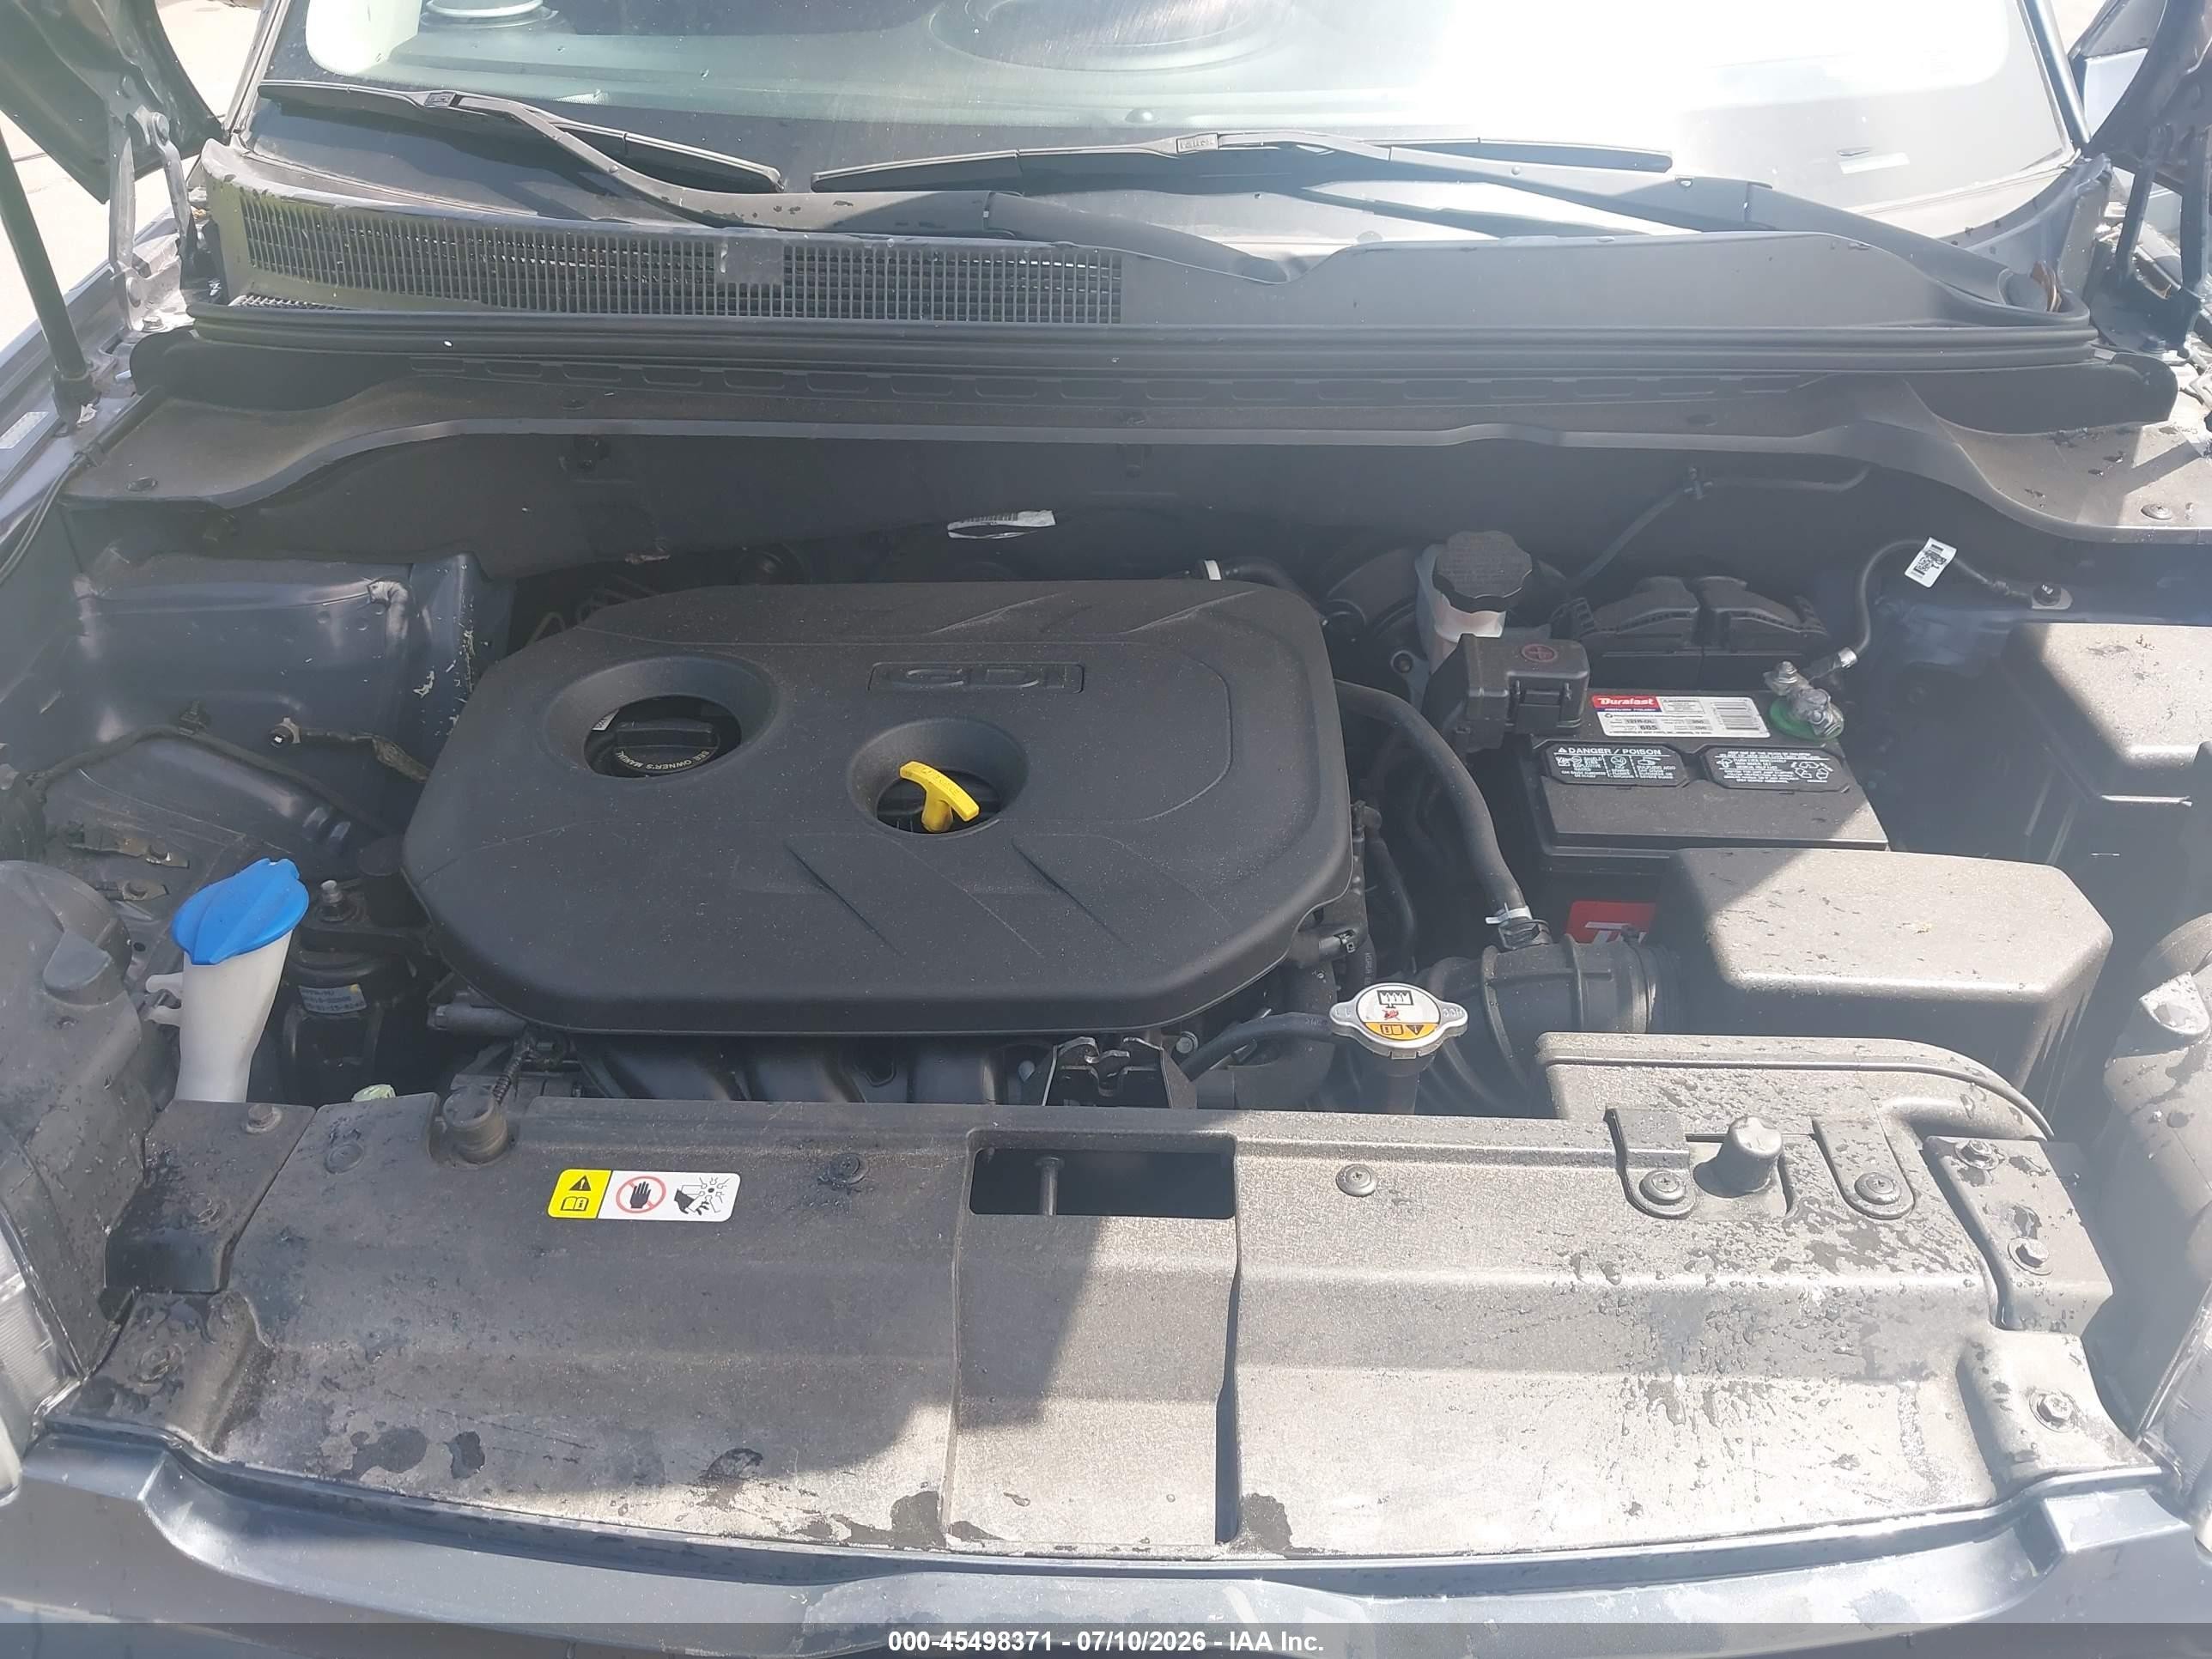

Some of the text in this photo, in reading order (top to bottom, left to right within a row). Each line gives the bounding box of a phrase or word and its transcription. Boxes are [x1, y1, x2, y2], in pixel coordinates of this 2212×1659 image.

[1597, 697, 1656, 706] Duralast
[692, 750, 710, 762] SEE
[646, 758, 692, 770] OWNER'S
